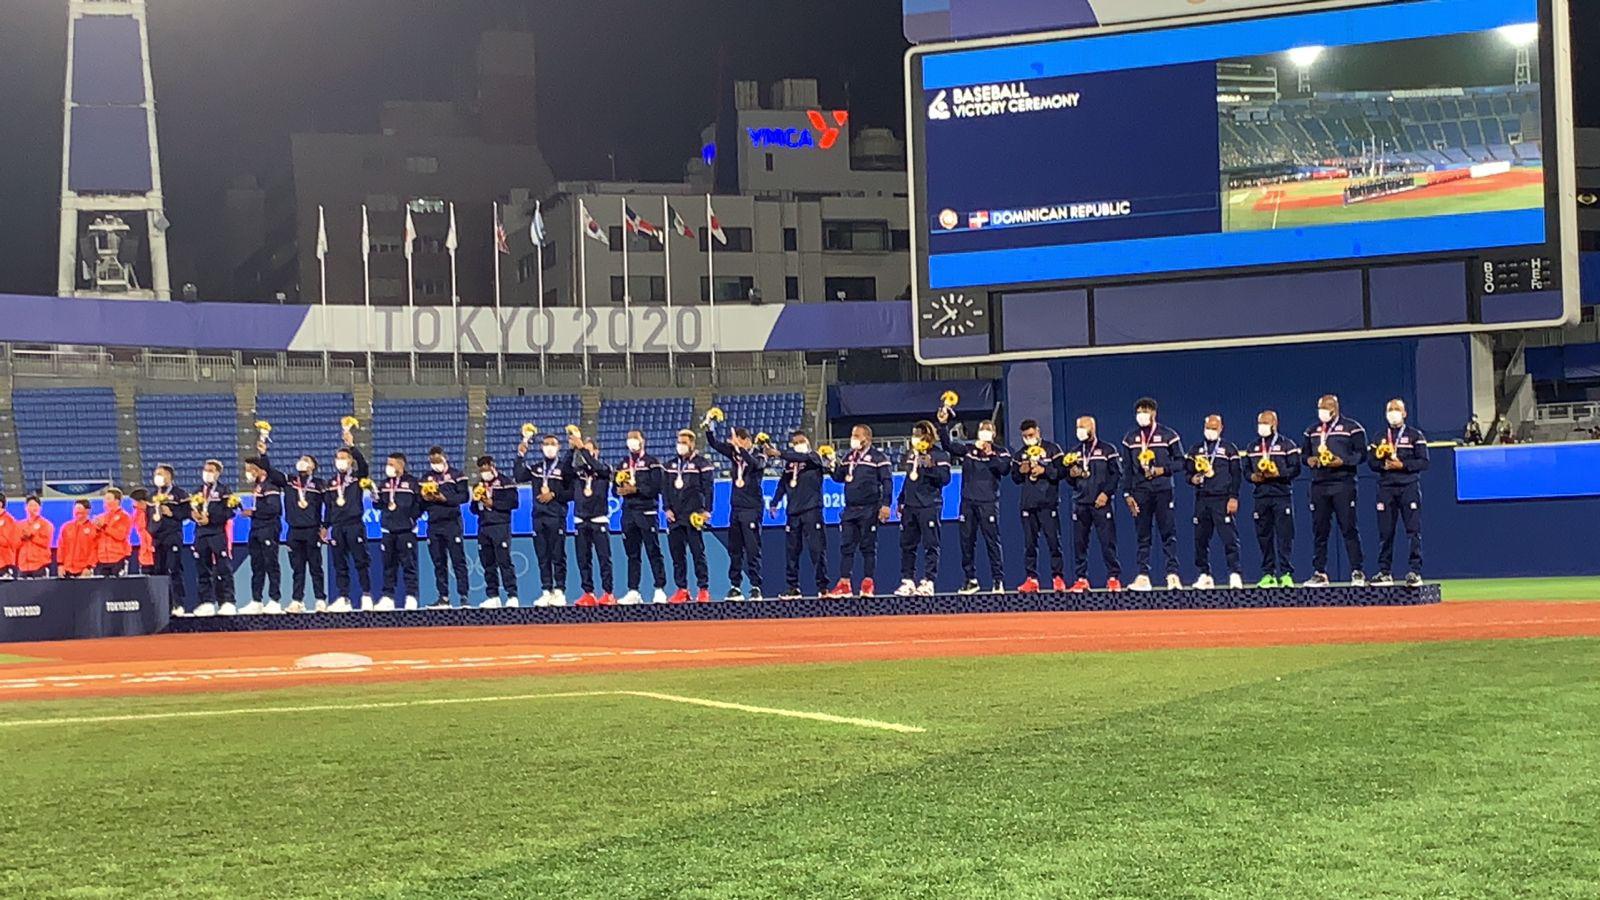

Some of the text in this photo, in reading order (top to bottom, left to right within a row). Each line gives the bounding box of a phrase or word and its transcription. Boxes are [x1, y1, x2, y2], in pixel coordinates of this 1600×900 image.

[952, 82, 1030, 104] BASEBALL
[953, 93, 1080, 118] VICTORY CEREMONY
[747, 127, 814, 149] YMCA
[992, 200, 1131, 226] DOMINICAN REPUBLIC
[374, 306, 702, 352] TOKYO 2020
